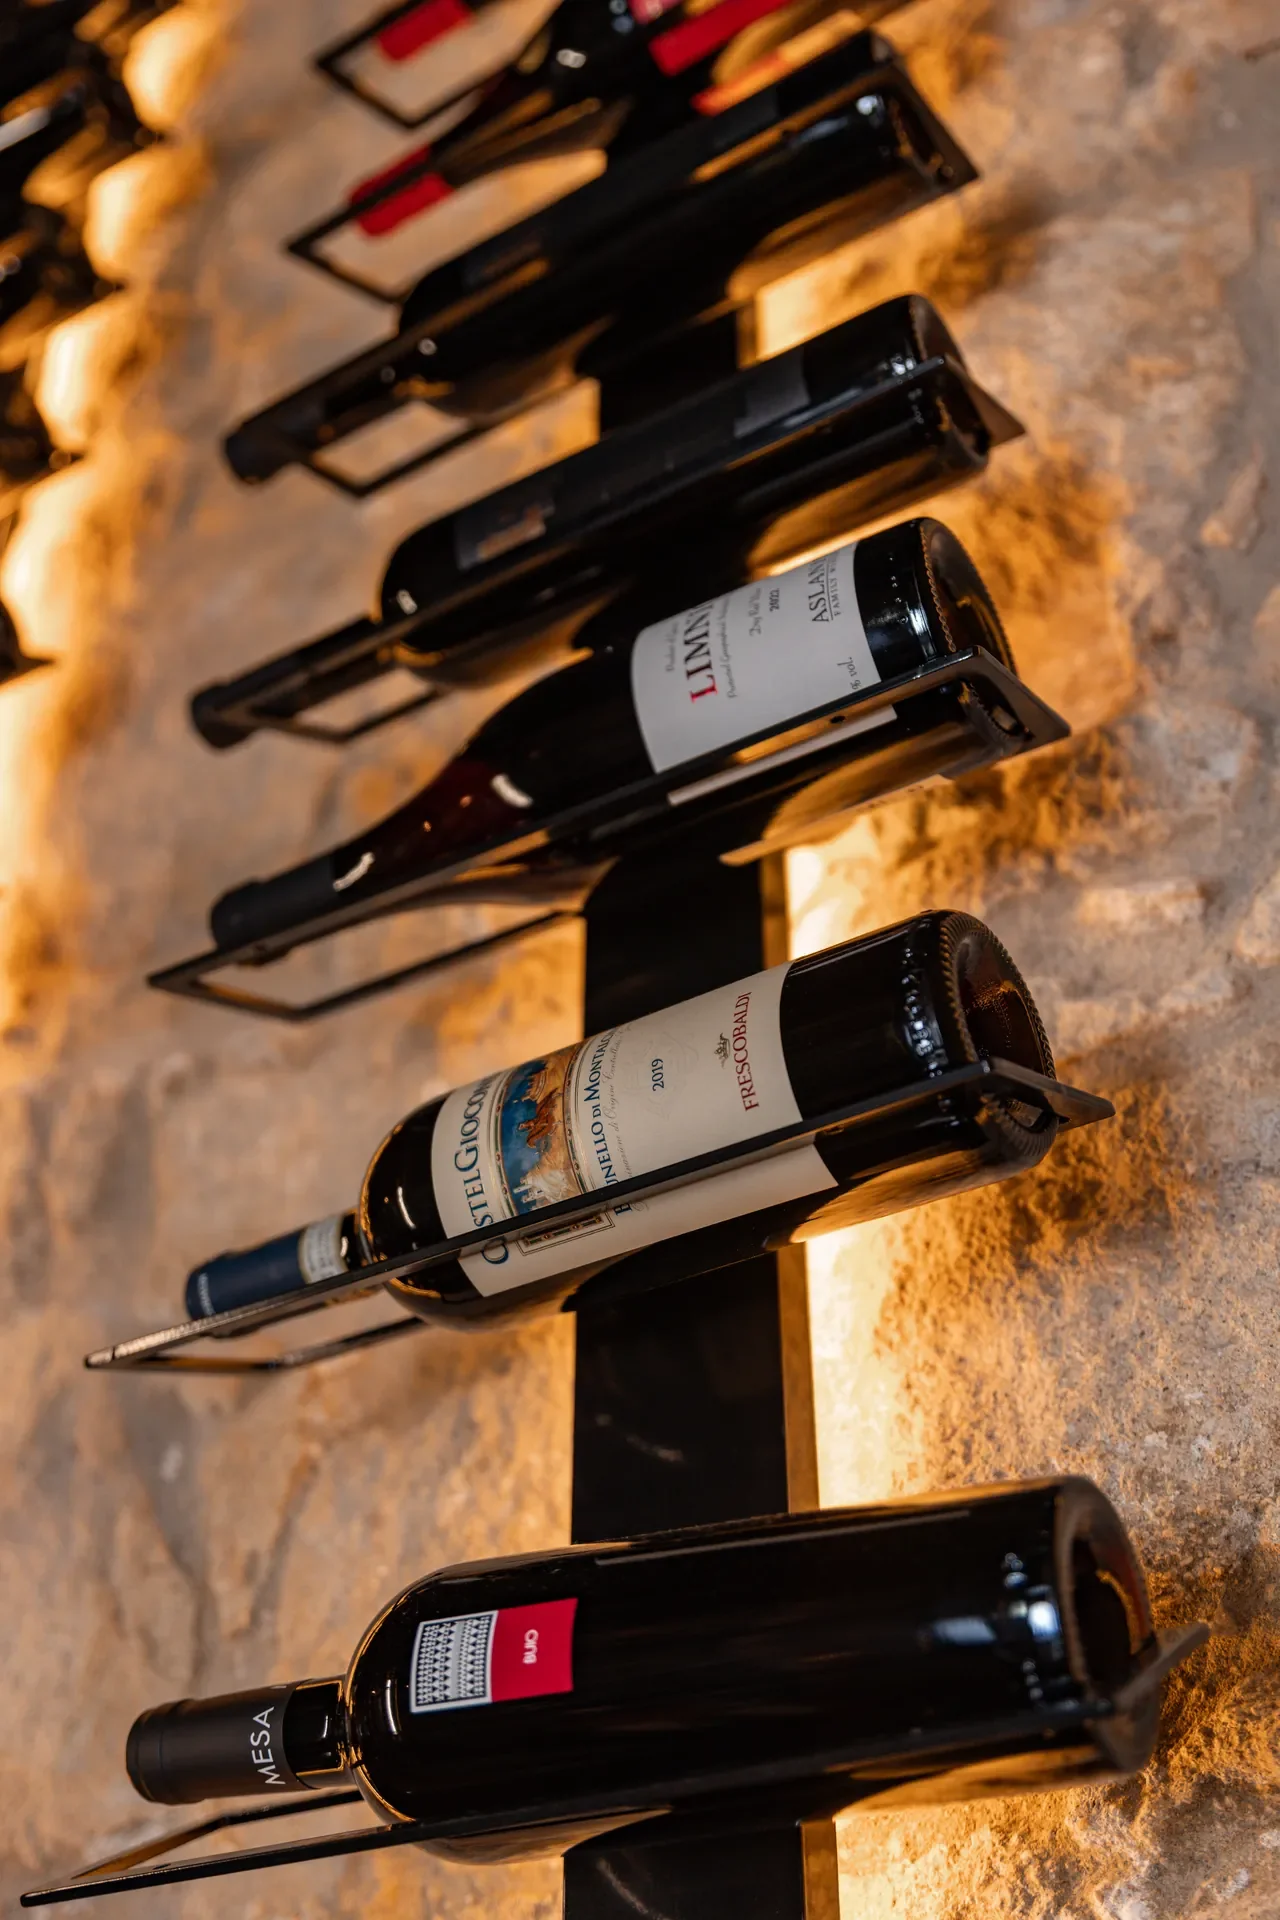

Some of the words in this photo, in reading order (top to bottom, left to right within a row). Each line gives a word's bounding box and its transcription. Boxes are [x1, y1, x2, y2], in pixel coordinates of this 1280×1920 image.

[828, 577, 841, 617] FAMILY
[651, 1058, 665, 1091] 2019
[732, 991, 760, 1111] FRESCOBALDI
[250, 1706, 286, 1785] MESA
